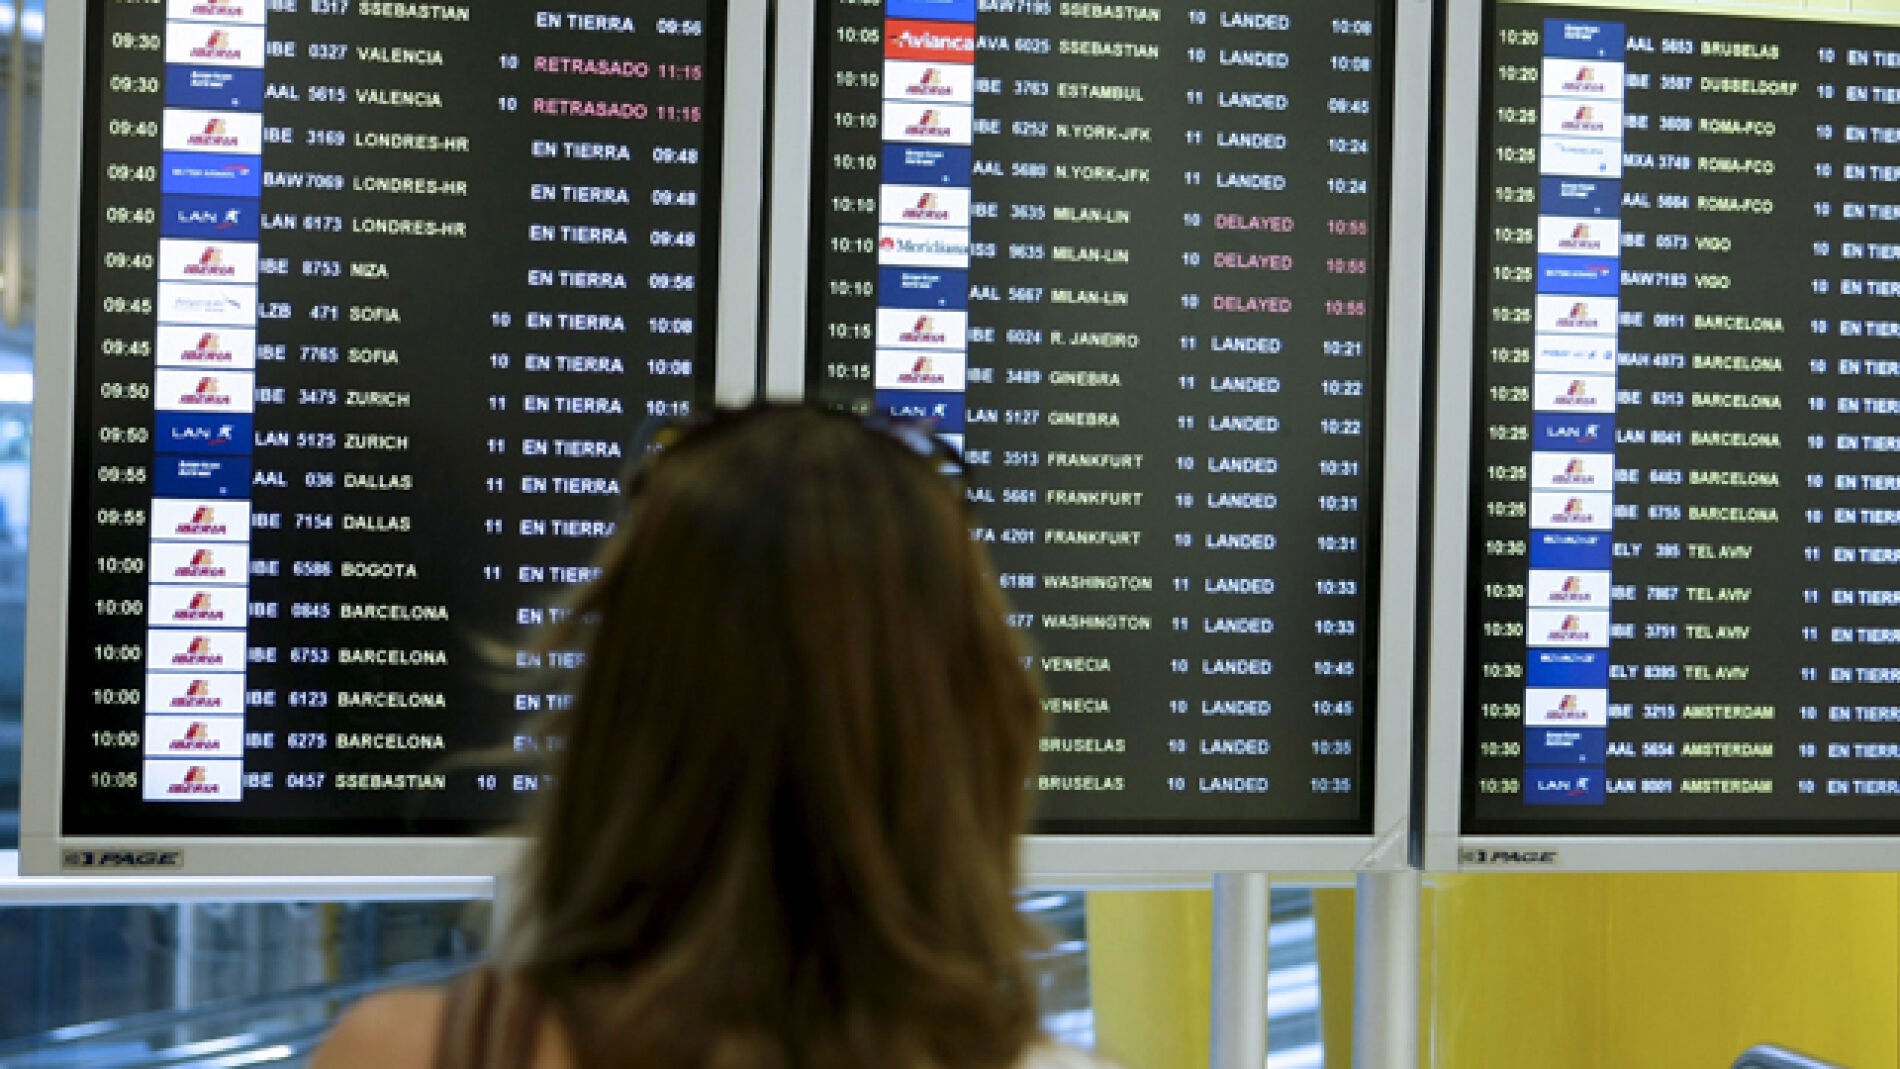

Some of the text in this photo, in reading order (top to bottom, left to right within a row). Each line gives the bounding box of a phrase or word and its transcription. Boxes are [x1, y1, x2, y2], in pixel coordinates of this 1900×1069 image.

[358, 1, 470, 22] SSEBASTIAN
[536, 11, 562, 28] EN
[566, 13, 636, 33] TIERRA
[1059, 2, 1290, 31] SSEBASTIAN LANDED
[112, 31, 161, 51] 09:30
[355, 46, 444, 66] VALENCIA
[533, 55, 649, 78] RETRASADO
[898, 29, 1290, 69] Avianca SSEBASTIAN LANDED
[1700, 40, 1780, 61] BRUSELAS
[109, 75, 159, 93] 09:30
[355, 88, 443, 108] VALENCIA
[533, 97, 648, 120] RETRASADO
[1056, 82, 1289, 111] ESTAMBUL LANDED
[1056, 124, 1150, 141] N.YORK-JFK
[1216, 132, 1287, 150] LANDED
[1697, 118, 1776, 137] ROMA-FCO
[109, 118, 158, 138] 09:40
[355, 132, 470, 152] LONDRES-HR
[530, 139, 559, 158] EN
[563, 141, 631, 161] TIERRA
[1697, 156, 1776, 176] ROMA-FCO
[106, 163, 156, 182] 09:40
[352, 175, 467, 197] LONDRES-HR
[530, 183, 556, 201] EN
[560, 183, 631, 205] TIERRA
[1055, 165, 1150, 182] N.YORK-JFK
[1216, 171, 1287, 191] LANDED
[1697, 195, 1774, 215] ROMA-FCO
[106, 207, 156, 224] 09:40
[352, 218, 467, 238] LONDRES-HR
[528, 224, 556, 242] EN
[560, 225, 628, 245] TIERRA
[1053, 207, 1295, 233] MILAN-LIN DELAYED
[1694, 236, 1732, 253] VIGO
[1052, 245, 1129, 263] MILAN-LIN
[1213, 252, 1292, 271] DELAYED
[103, 251, 155, 271] 09:40
[349, 263, 390, 280] NIZA
[527, 269, 554, 287] EN
[557, 269, 628, 289] TIERRA
[1694, 273, 1732, 289] VIGO
[1050, 287, 1292, 313] MILAN-LIN DELAYED
[103, 296, 153, 316] 09:45
[349, 305, 402, 322] SOFIA
[525, 311, 553, 330] EN
[557, 313, 627, 331] TIERRA
[1694, 314, 1785, 333] BARCELONA
[1050, 329, 1066, 345] R.
[1070, 331, 1141, 349] JANEIRO
[1210, 336, 1283, 354] LANDED
[100, 338, 152, 357] 09:45
[346, 346, 399, 364] SOFIA
[524, 352, 551, 371] EN
[554, 354, 625, 375] TIERRA
[1691, 354, 1782, 372] BARCELONA
[1047, 370, 1281, 393] GINEBRA LANDED
[100, 382, 150, 399] 09:50
[344, 391, 411, 408] ZURICH
[524, 394, 550, 414] EN
[554, 396, 624, 414] TIERRA
[1691, 391, 1782, 410] BARCELONA
[1047, 411, 1281, 432] GINEBRA LANDED
[98, 426, 150, 444] 09:50
[343, 433, 408, 450] ZURICH
[521, 438, 550, 456] EN
[554, 438, 622, 458] TIERRA
[1691, 430, 1782, 447] BARCELONA
[1047, 451, 1278, 474] FRANKFURT LANDED
[97, 465, 622, 496] 09:55 DALLAS EN TIERRA
[1688, 469, 1780, 488] BARCELONA
[1047, 489, 1144, 506] FRANKFURT
[1207, 492, 1278, 509] LANDED
[97, 507, 411, 533] 09:55 DALLAS
[1688, 506, 1779, 523] BARCELONA
[1044, 529, 1278, 550] FRANKFURT LANDED
[1688, 542, 1753, 559] TEL AVIV
[97, 555, 417, 579] 10:00 BOGOTA
[1044, 575, 1275, 595] WASHINGTON LANDED
[1483, 584, 1752, 601] 10:30 TEL AVIV
[94, 599, 449, 622] 10:00 BARCELONA
[1041, 614, 1150, 631] WASHINGTON
[1204, 617, 1275, 634] LANDED
[1685, 623, 1750, 640] TEL AVIV
[94, 643, 448, 666] 10:00 BARCELONA
[1041, 655, 1273, 675] VENECIA LANDED
[1483, 662, 1750, 681] 10:30 TEL AVIV
[91, 688, 447, 708] 10:00 BARCELONA
[1041, 697, 1109, 714] VENECIA
[1201, 700, 1272, 717] LANDED
[1480, 703, 1776, 720] 10:30 AMSTERDAM
[91, 730, 446, 750] 10:00 BARCELONA
[1038, 738, 1271, 755] BRUSELAS LANDED
[1679, 741, 1774, 758] AMSTERDAM
[91, 771, 446, 791] 10:05 SSEBASTIAN
[1038, 774, 1269, 793] BRUSELAS LANDED
[1478, 777, 1521, 794] 10:30
[1679, 777, 1773, 794] AMSTERDAM
